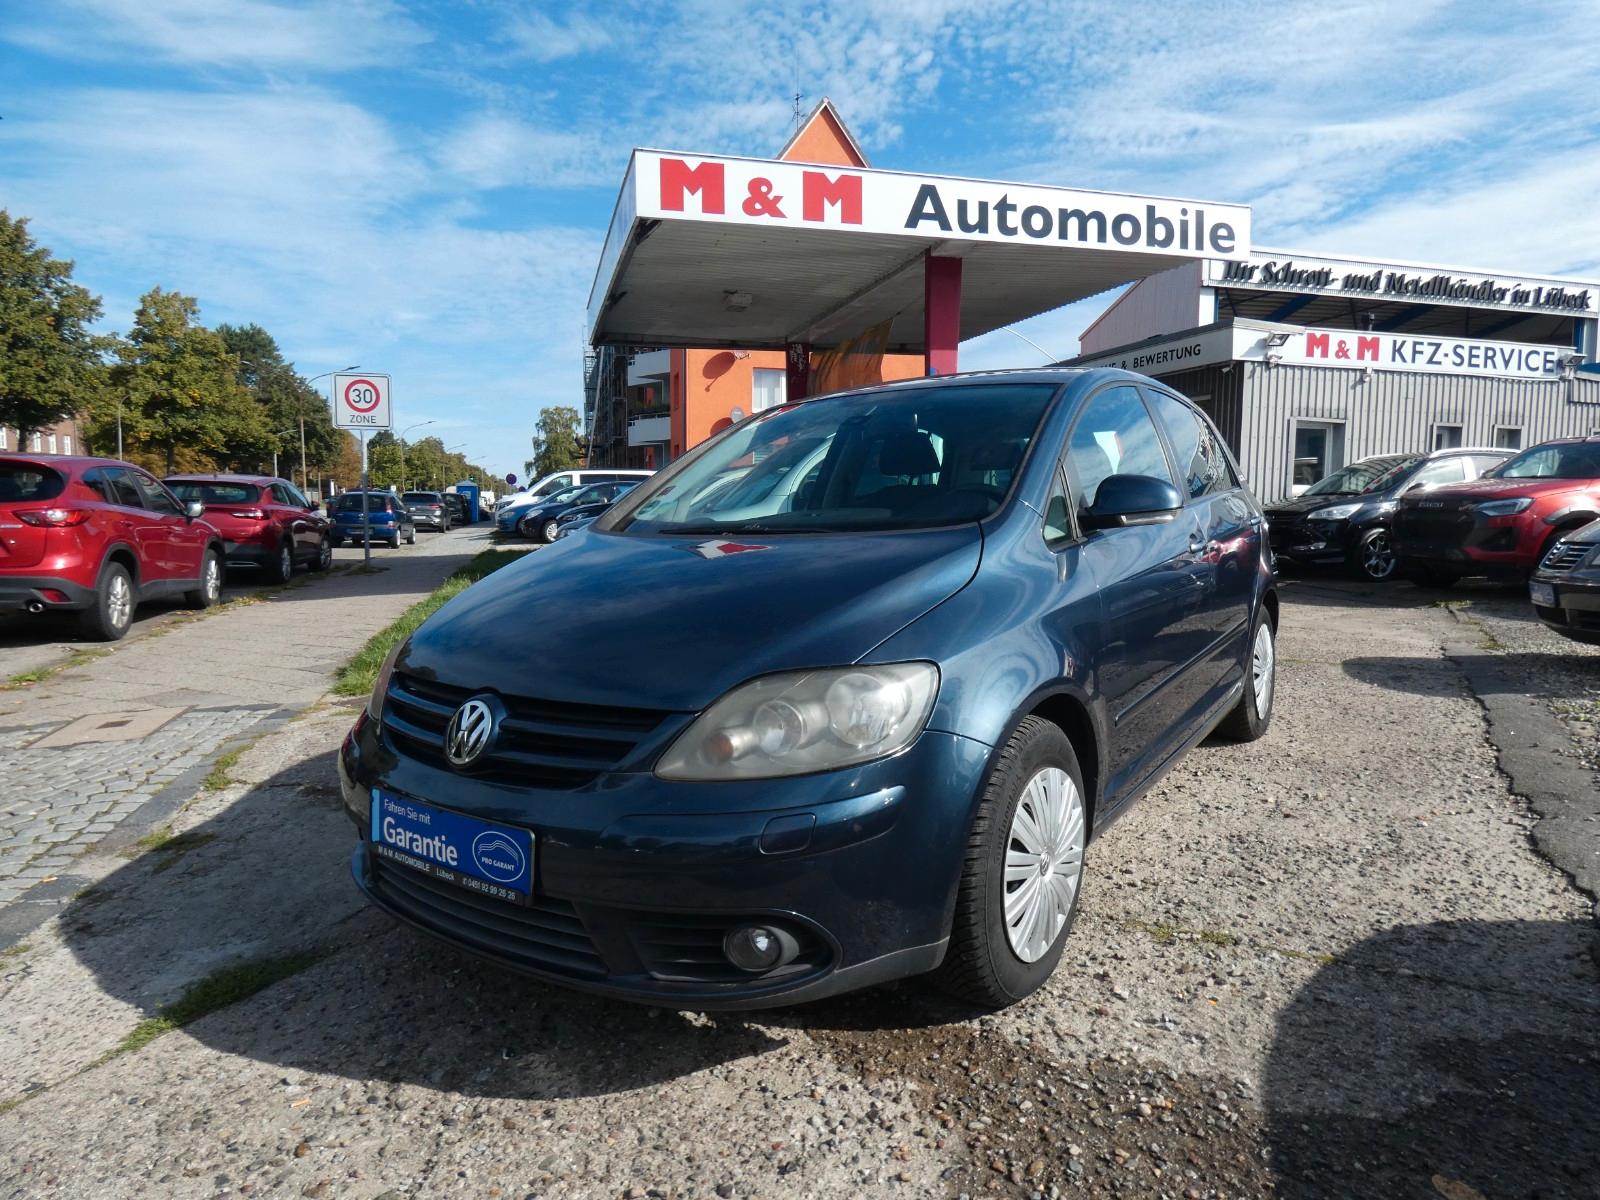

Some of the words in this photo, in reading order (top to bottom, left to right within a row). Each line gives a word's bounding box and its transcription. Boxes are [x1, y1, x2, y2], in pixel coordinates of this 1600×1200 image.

[659, 158, 725, 215] M
[741, 176, 787, 218] &
[802, 171, 863, 225] M
[904, 184, 1236, 253] Automobile
[1340, 270, 1383, 291] und
[1531, 286, 1592, 310] Lübeck
[1133, 343, 1201, 369] BEWERTUNG
[1305, 332, 1330, 359] M
[1334, 339, 1351, 360] &
[1356, 336, 1381, 362] M
[352, 388, 373, 404] 30
[349, 414, 377, 424] ZONE
[384, 798, 406, 817] Fahren
[406, 806, 418, 821] Sie
[418, 813, 431, 825] mit
[383, 817, 458, 867] Garantie
[394, 851, 430, 872] AUTOMOBILE
[493, 860, 515, 871] GARANT
